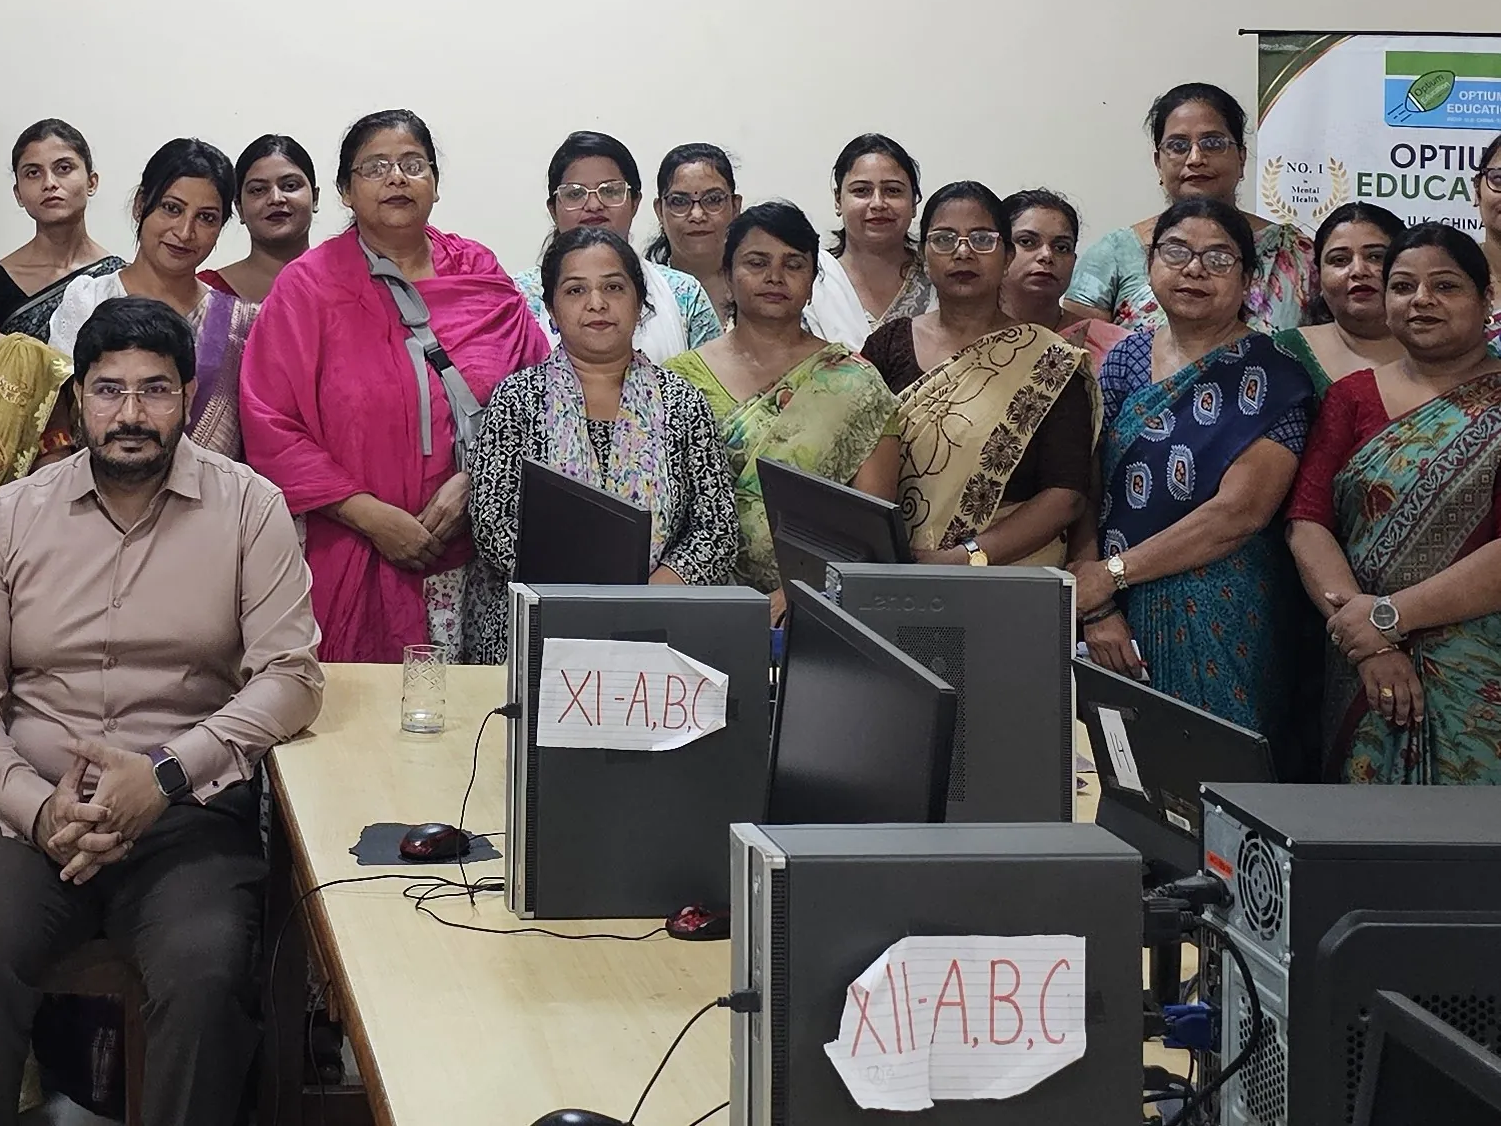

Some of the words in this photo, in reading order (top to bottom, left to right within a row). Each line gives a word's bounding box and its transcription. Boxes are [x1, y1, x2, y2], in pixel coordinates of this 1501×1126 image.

[1414, 74, 1445, 96] Optium
[1390, 143, 1489, 172] OPTIU
[1286, 162, 1312, 174] NO.
[1291, 185, 1320, 194] Mental
[1357, 172, 1477, 202] EDUCA
[1292, 195, 1319, 203] Health
